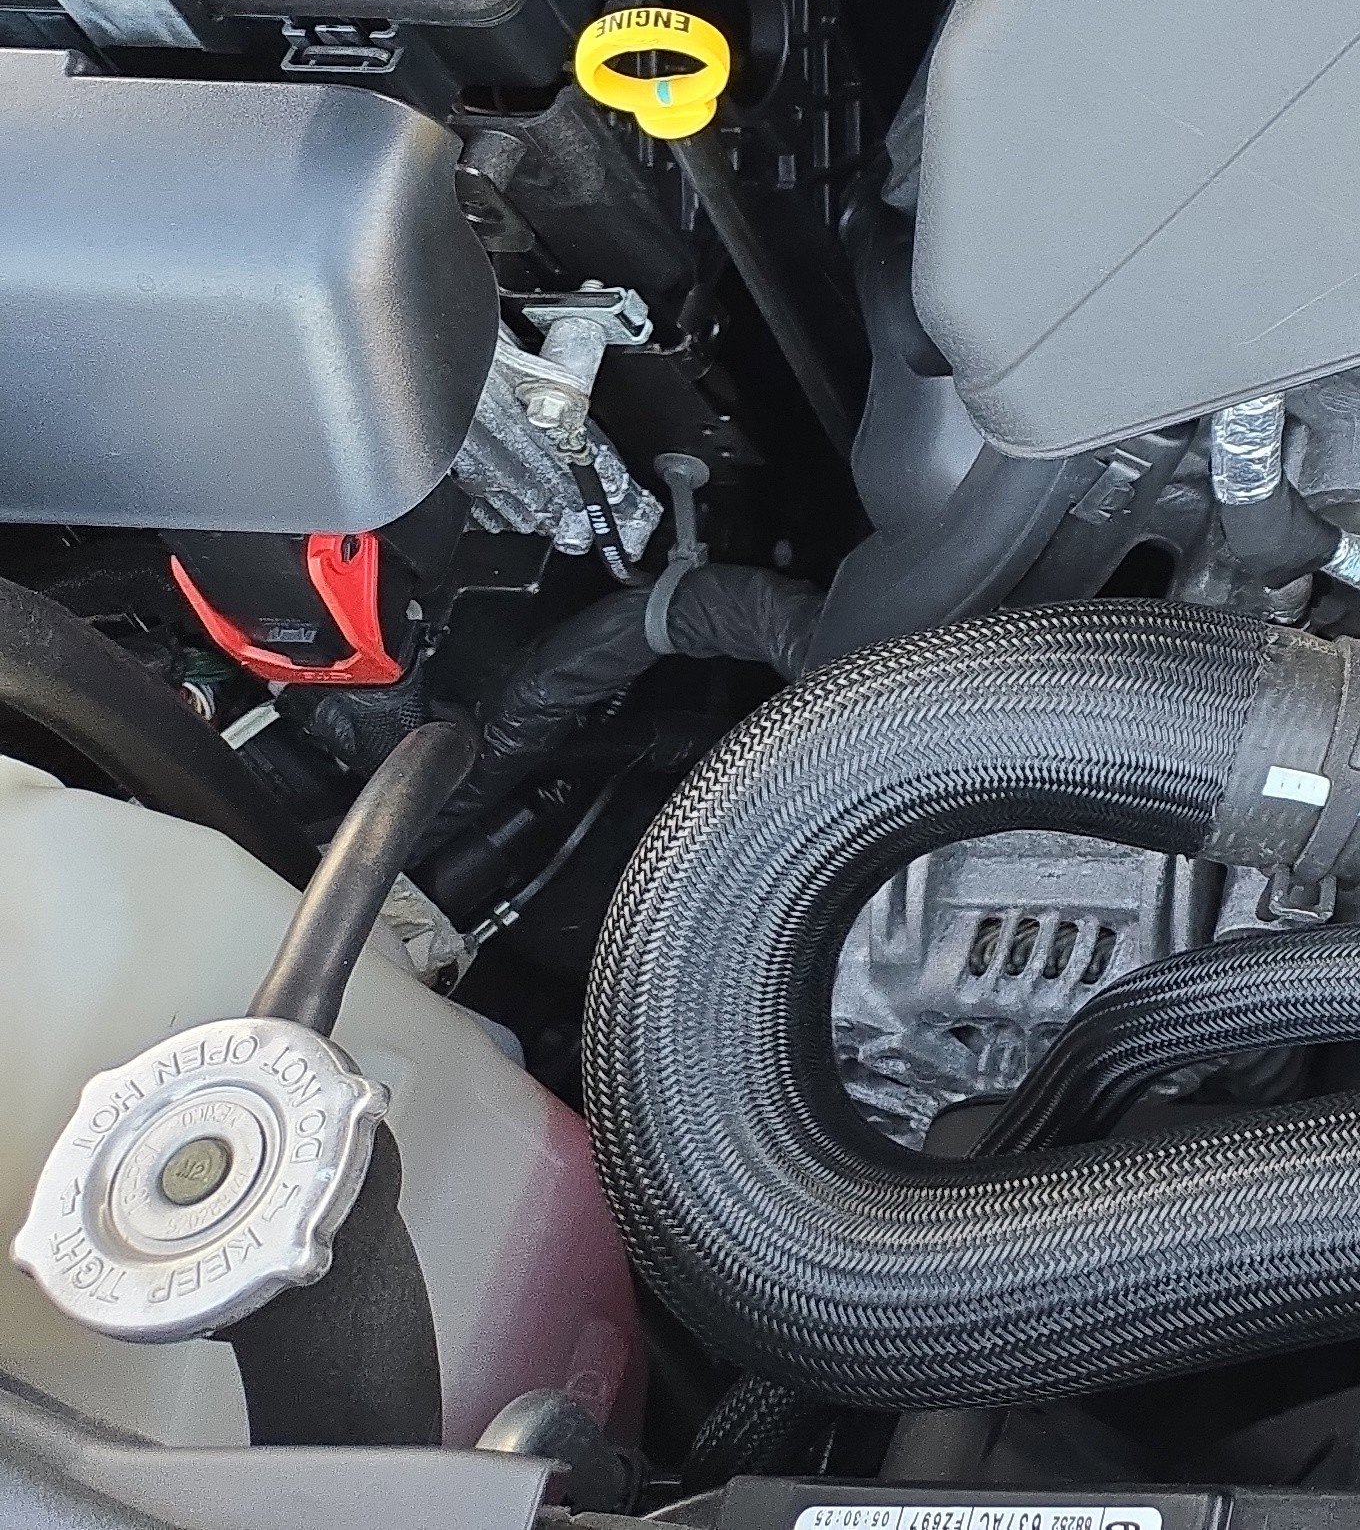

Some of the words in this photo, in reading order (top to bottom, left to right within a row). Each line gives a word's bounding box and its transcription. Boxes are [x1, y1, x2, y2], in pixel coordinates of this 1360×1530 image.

[595, 10, 691, 38] ENGINE
[149, 1033, 260, 1086] OPEN
[261, 1045, 321, 1107] NOT
[72, 1079, 145, 1156] HOT
[288, 1108, 326, 1164] DO
[47, 1225, 128, 1304] TIGHT
[147, 1227, 262, 1304] KEEP
[814, 1511, 890, 1527] 05:30:25
